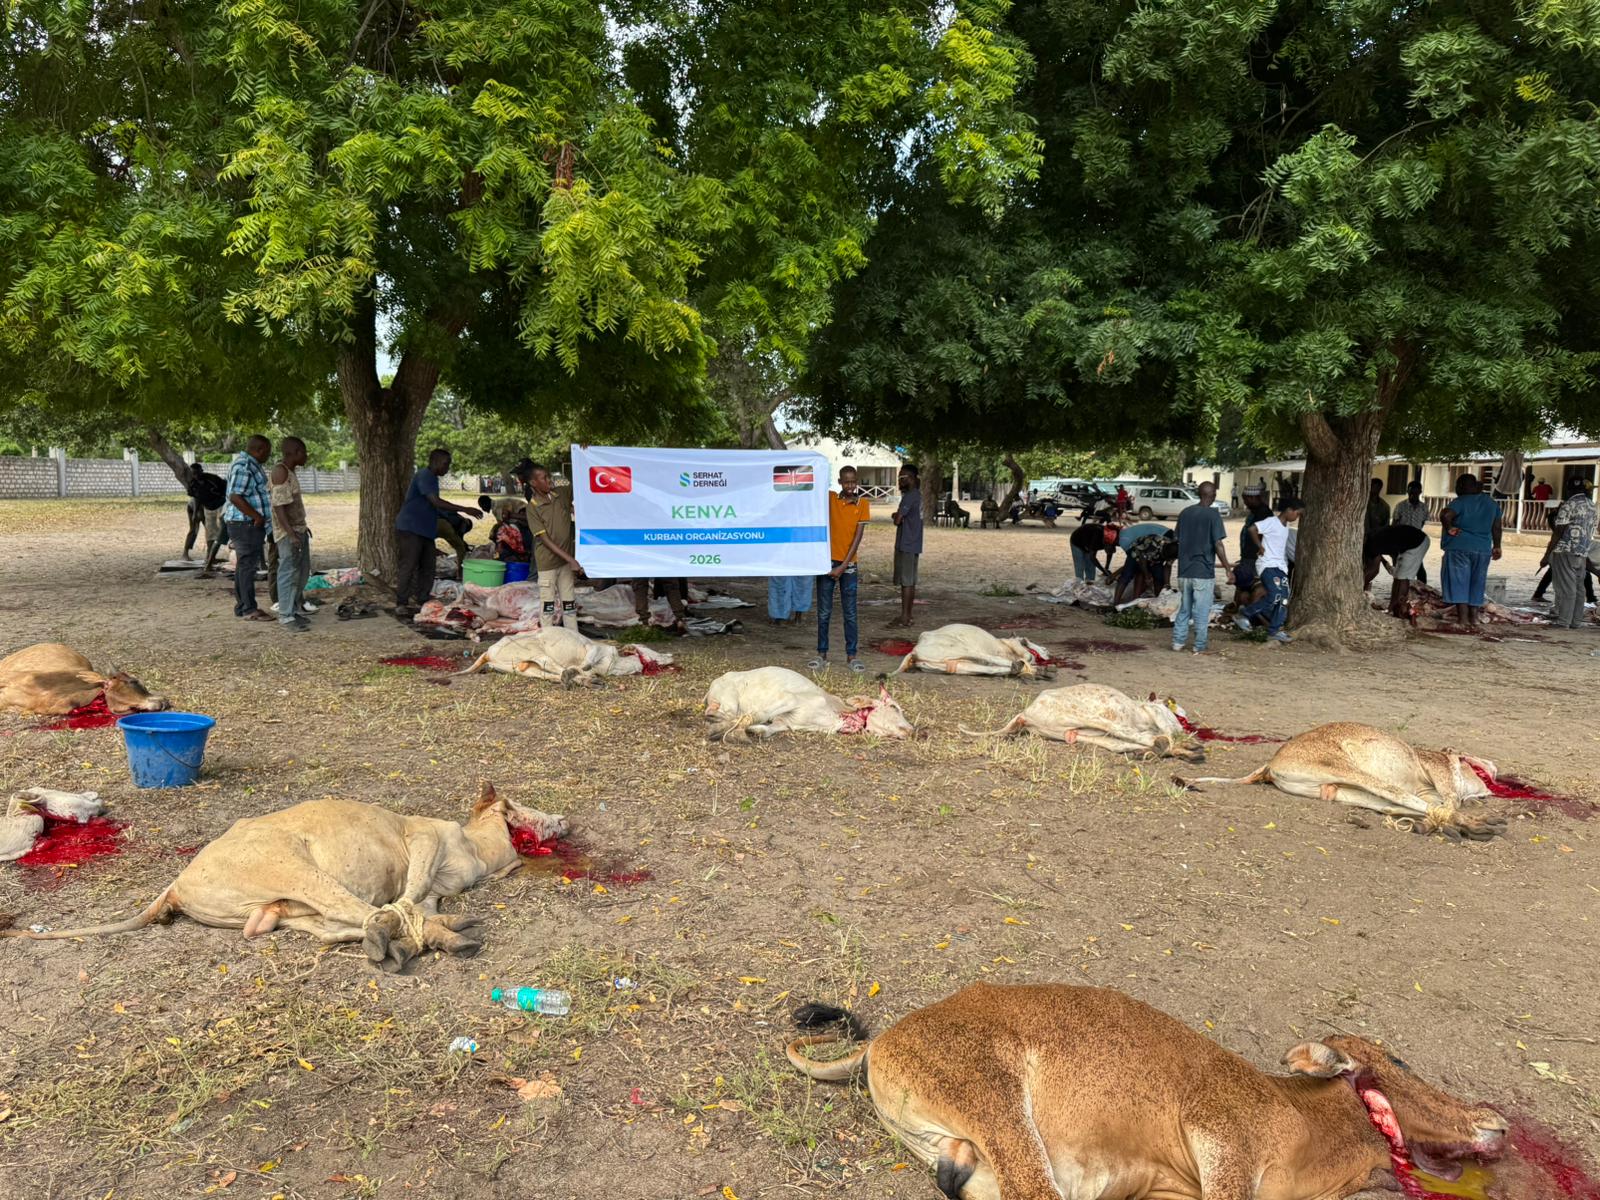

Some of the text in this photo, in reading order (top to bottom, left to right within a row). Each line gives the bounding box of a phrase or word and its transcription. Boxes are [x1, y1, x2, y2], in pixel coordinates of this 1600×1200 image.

[692, 471, 724, 479] SERHAT
[693, 479, 727, 488] DERNEĞİ
[671, 504, 737, 519] KENYA
[643, 530, 765, 541] KURBAN ORGANİZASYONU
[688, 554, 722, 565] 2026
